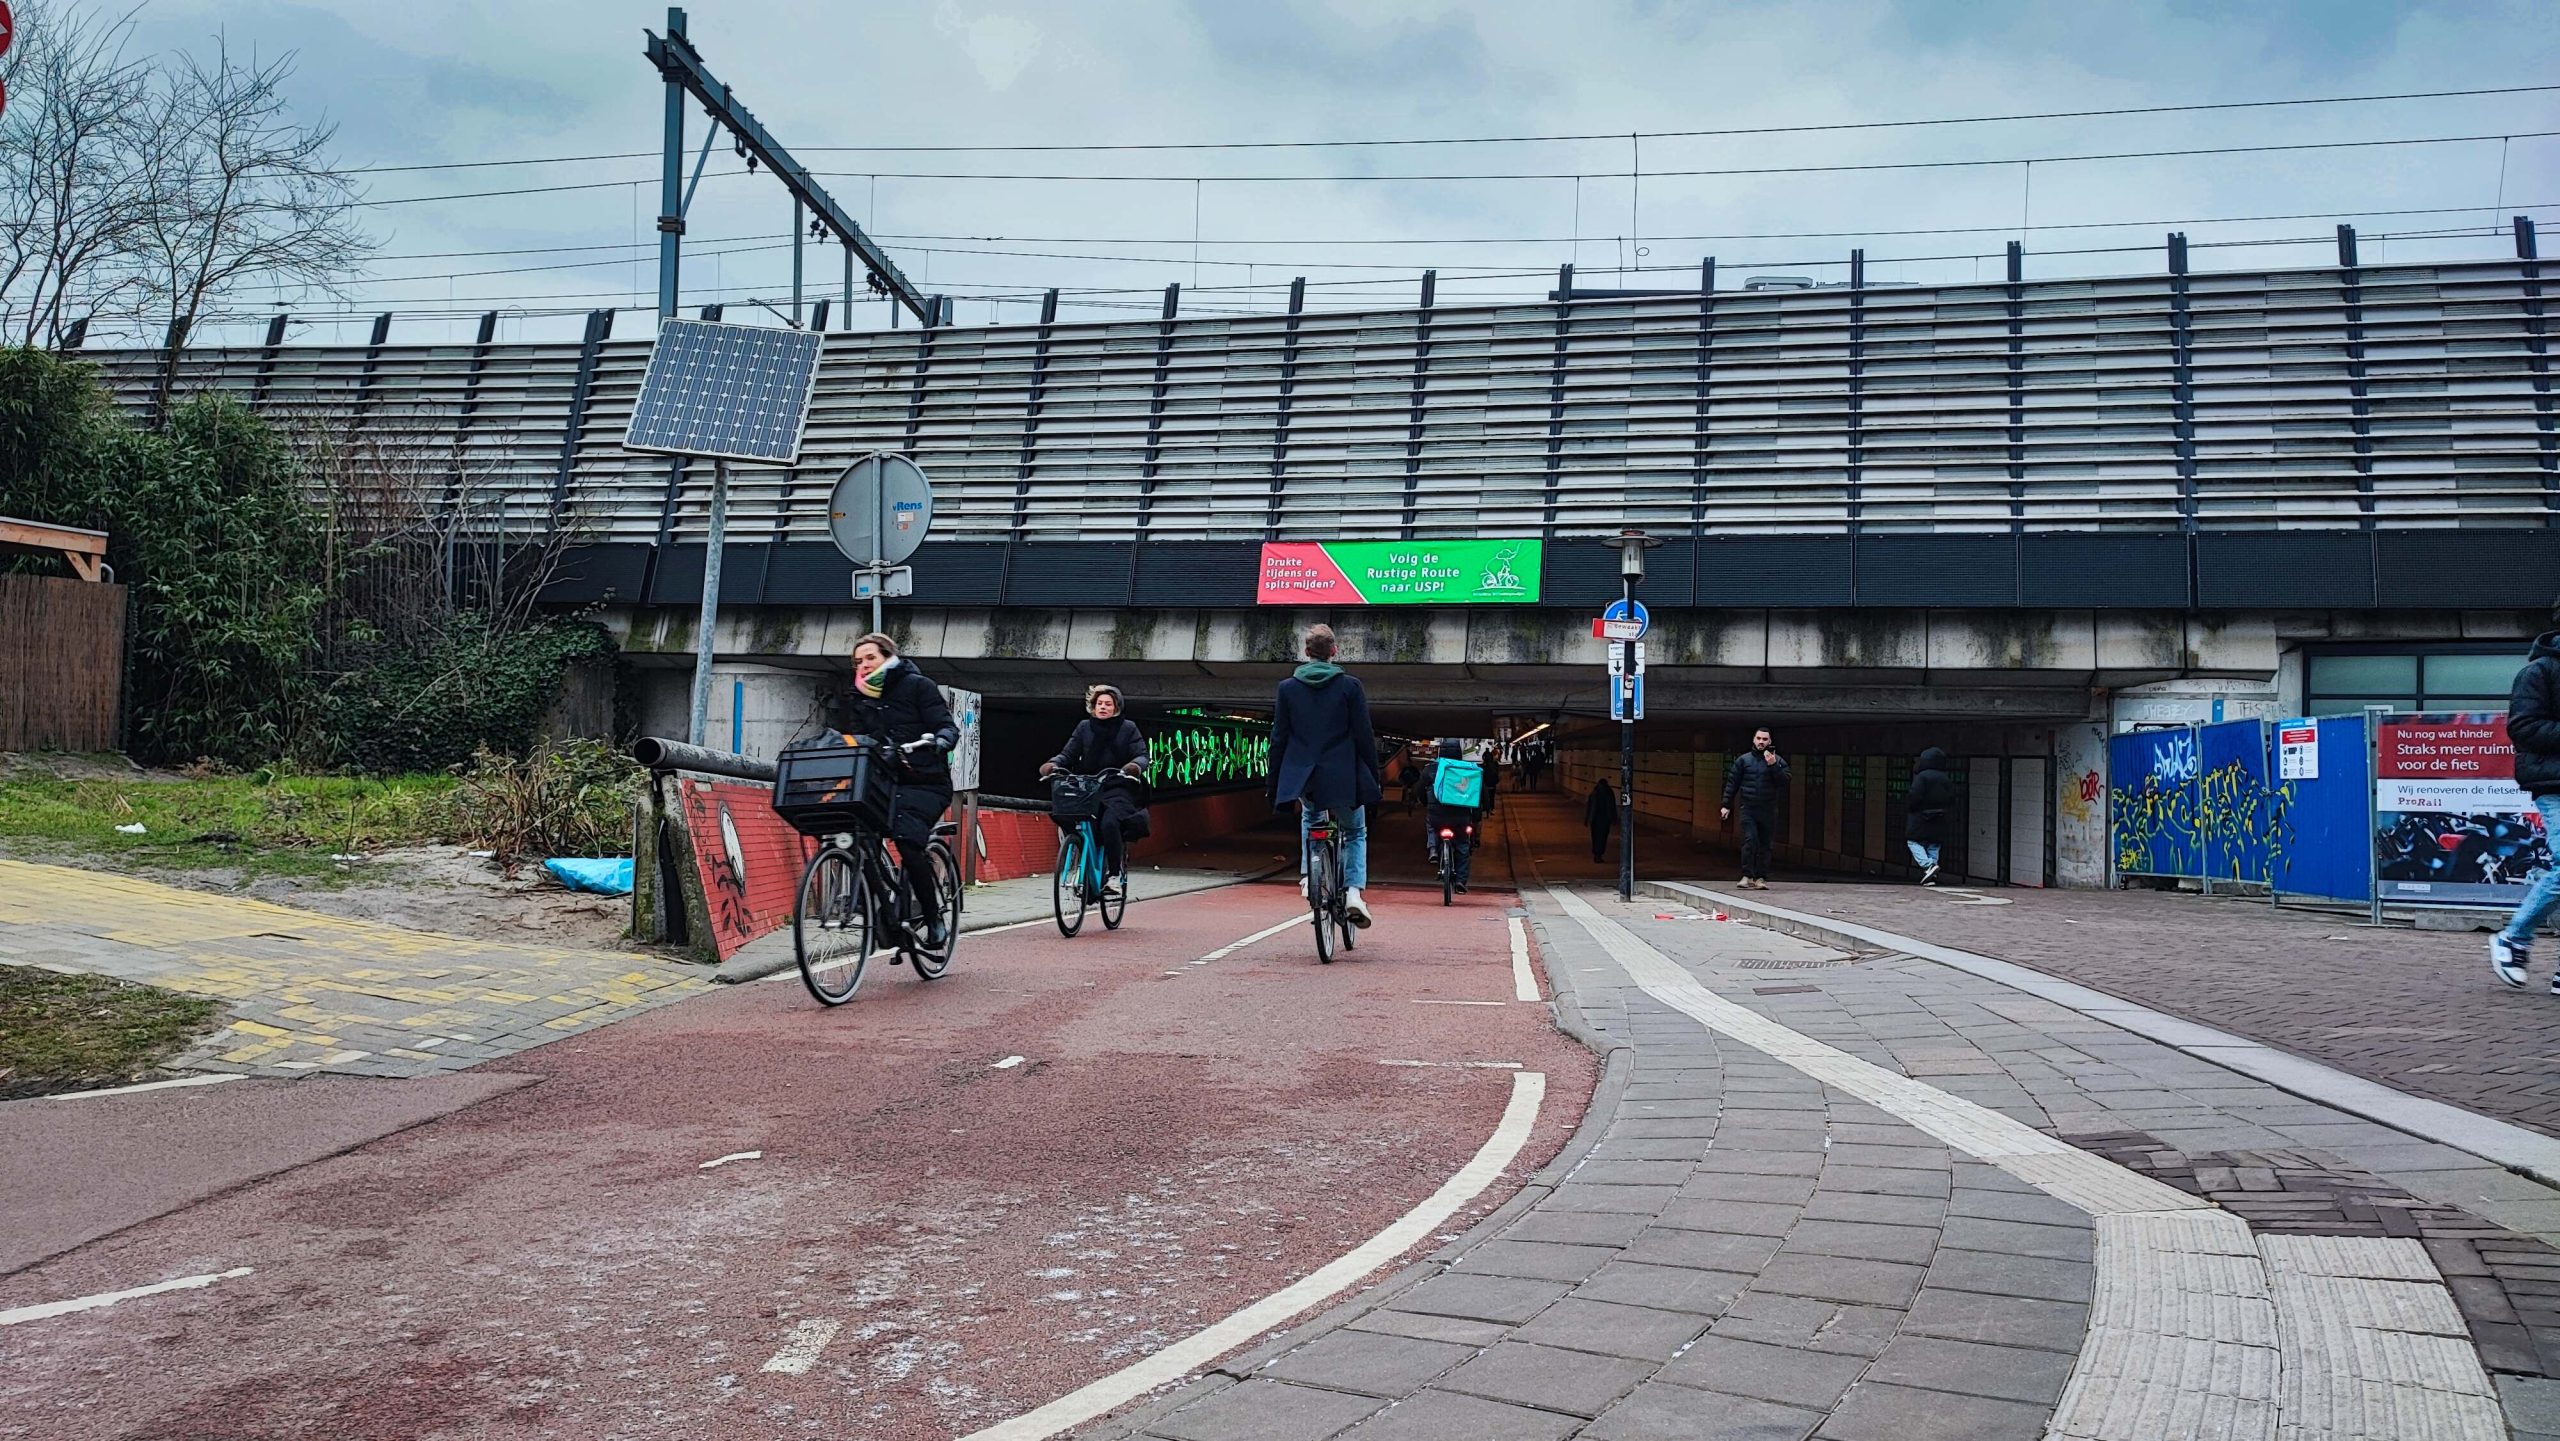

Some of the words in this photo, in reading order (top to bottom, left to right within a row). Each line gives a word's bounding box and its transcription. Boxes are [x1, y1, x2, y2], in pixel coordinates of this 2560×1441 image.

[1267, 557, 1302, 567] Drukte
[1389, 553, 1418, 566] Volg
[1423, 552, 1439, 564] de
[1266, 568, 1302, 579] tijdens
[1305, 568, 1318, 578] de
[1367, 567, 1417, 580] Rustige
[1421, 567, 1460, 578] Route
[1265, 579, 1290, 590] spits
[1293, 579, 1336, 590] mijden?
[1381, 583, 1411, 593] naar
[1414, 581, 1445, 592] USP!
[2397, 730, 2413, 739] Nu
[2415, 731, 2435, 741] nog
[2438, 730, 2457, 739] wat
[2460, 729, 2494, 739] hinder
[2397, 743, 2437, 755] Straks
[2440, 745, 2474, 755] meer
[2478, 743, 2516, 755] ruimt
[2397, 760, 2427, 771] voor
[2430, 759, 2448, 771] de
[2451, 758, 2480, 771] fiets
[2398, 785, 2414, 796] Wij
[2416, 787, 2468, 795] renoveren
[2471, 785, 2485, 795] de
[2398, 797, 2442, 807] ProRail
